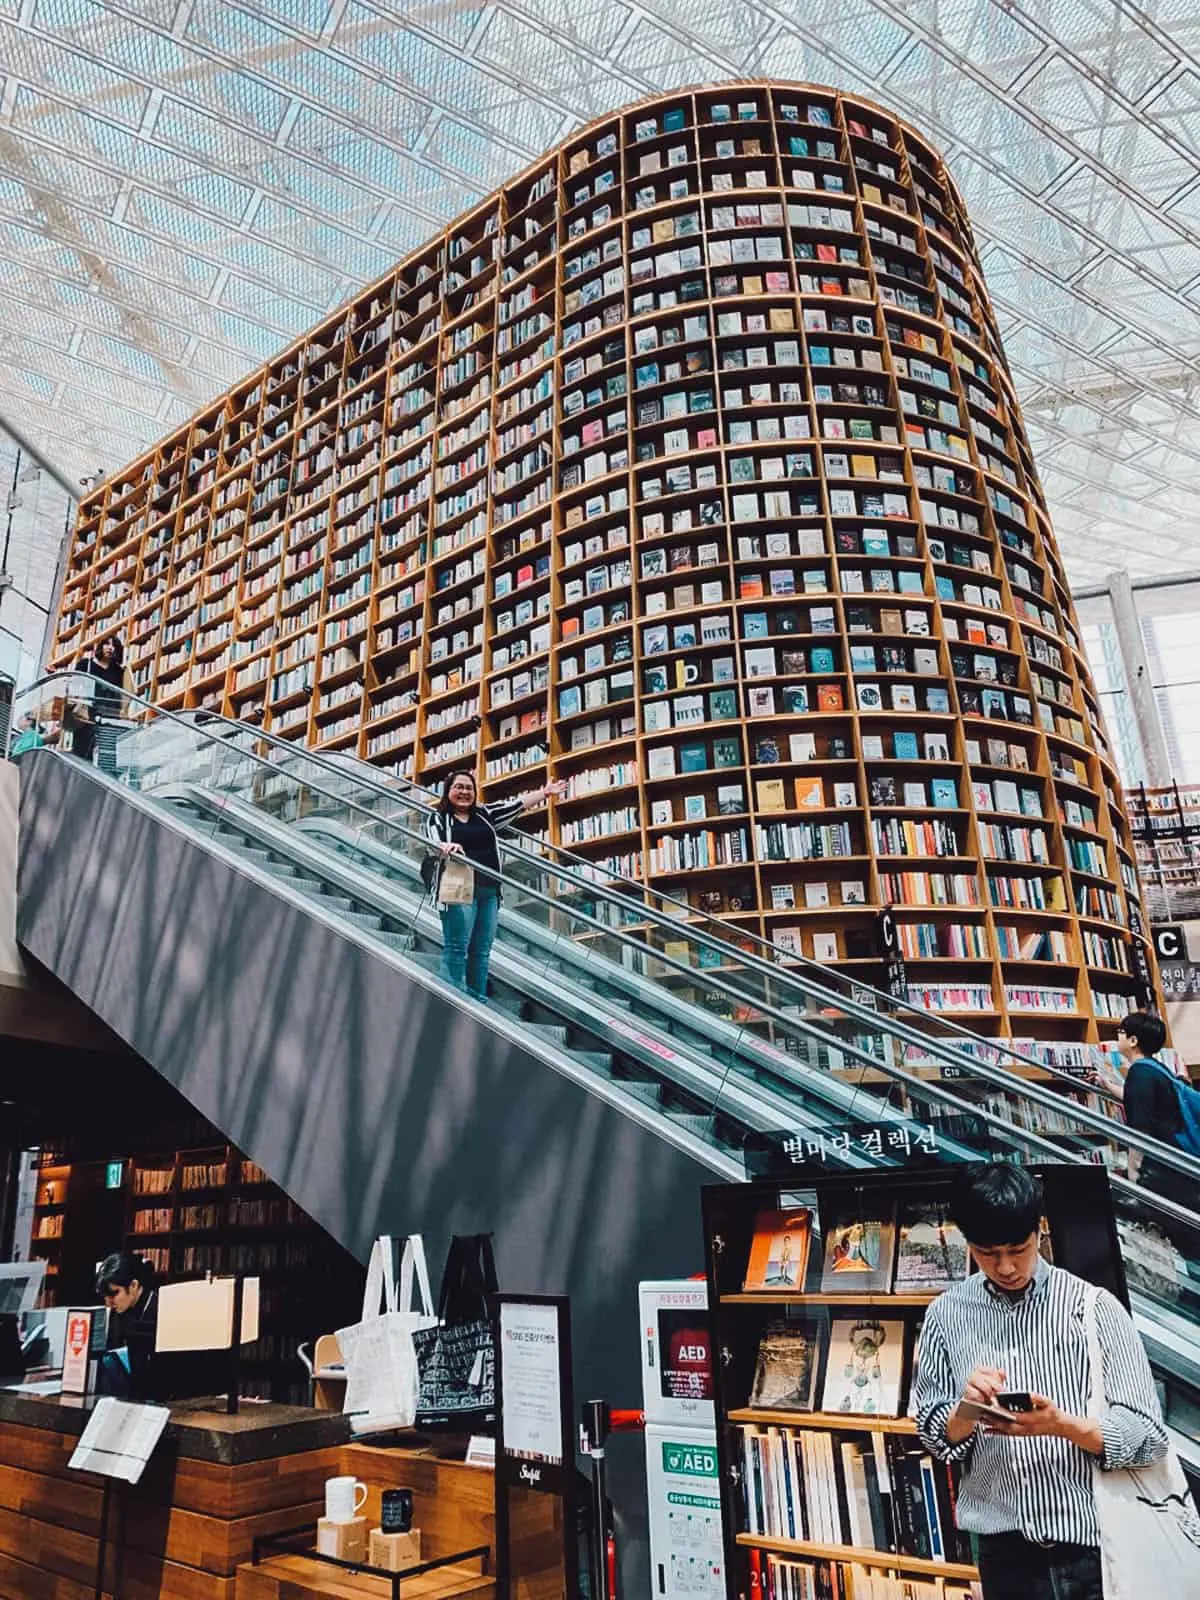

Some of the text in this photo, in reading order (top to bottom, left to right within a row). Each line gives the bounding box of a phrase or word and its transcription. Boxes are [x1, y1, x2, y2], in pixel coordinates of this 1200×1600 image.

[883, 915, 893, 946] C
[1158, 931, 1179, 956] C
[783, 1125, 940, 1164] 별마당 컬렉션
[679, 1345, 706, 1360] AED
[683, 1454, 714, 1472] AED
